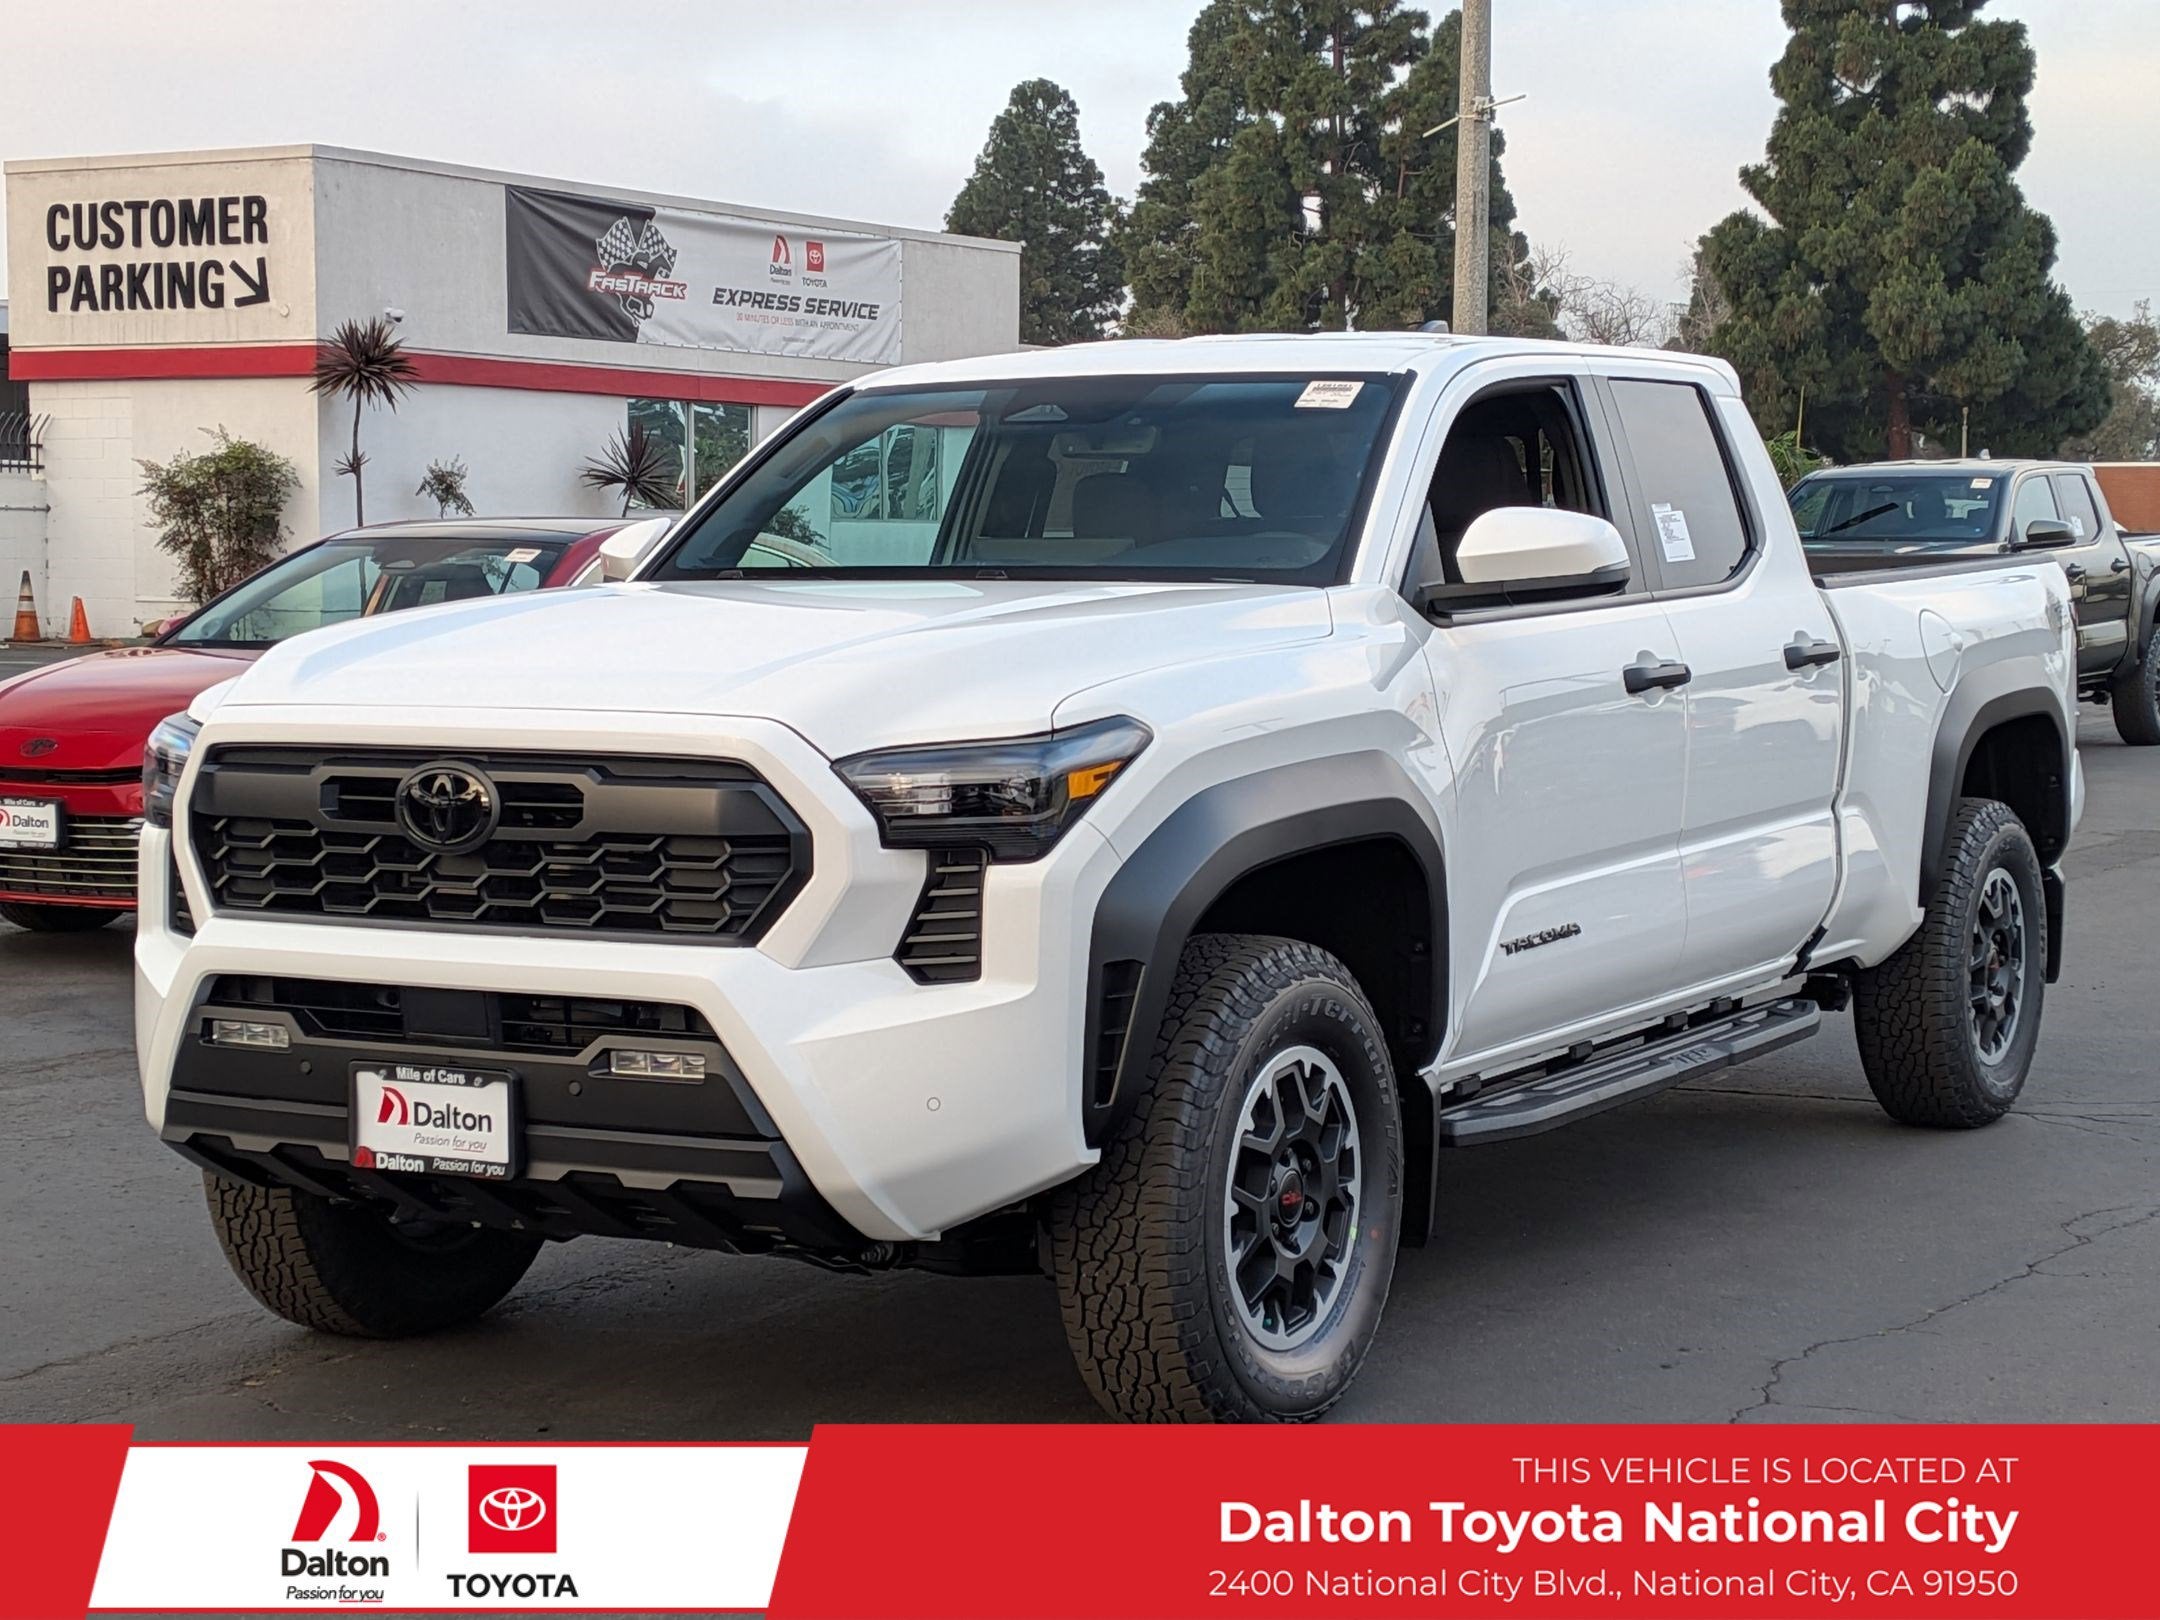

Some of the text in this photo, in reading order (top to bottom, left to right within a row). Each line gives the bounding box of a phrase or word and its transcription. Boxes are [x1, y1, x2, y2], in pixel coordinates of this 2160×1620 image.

[46, 195, 269, 251] CUSTOMER
[769, 264, 792, 277] Dalton
[801, 277, 828, 288] TOYOTA
[47, 259, 225, 312] PARKING
[712, 287, 880, 321] EXPRESS SERVICE
[12, 815, 49, 828] Dalton
[1500, 922, 1582, 956] TACOMA
[396, 1067, 466, 1085] Mile of Cars
[413, 1101, 492, 1133] Dalton
[413, 1132, 488, 1151] Passion for you
[376, 1152, 506, 1177] Dalton Passion for you
